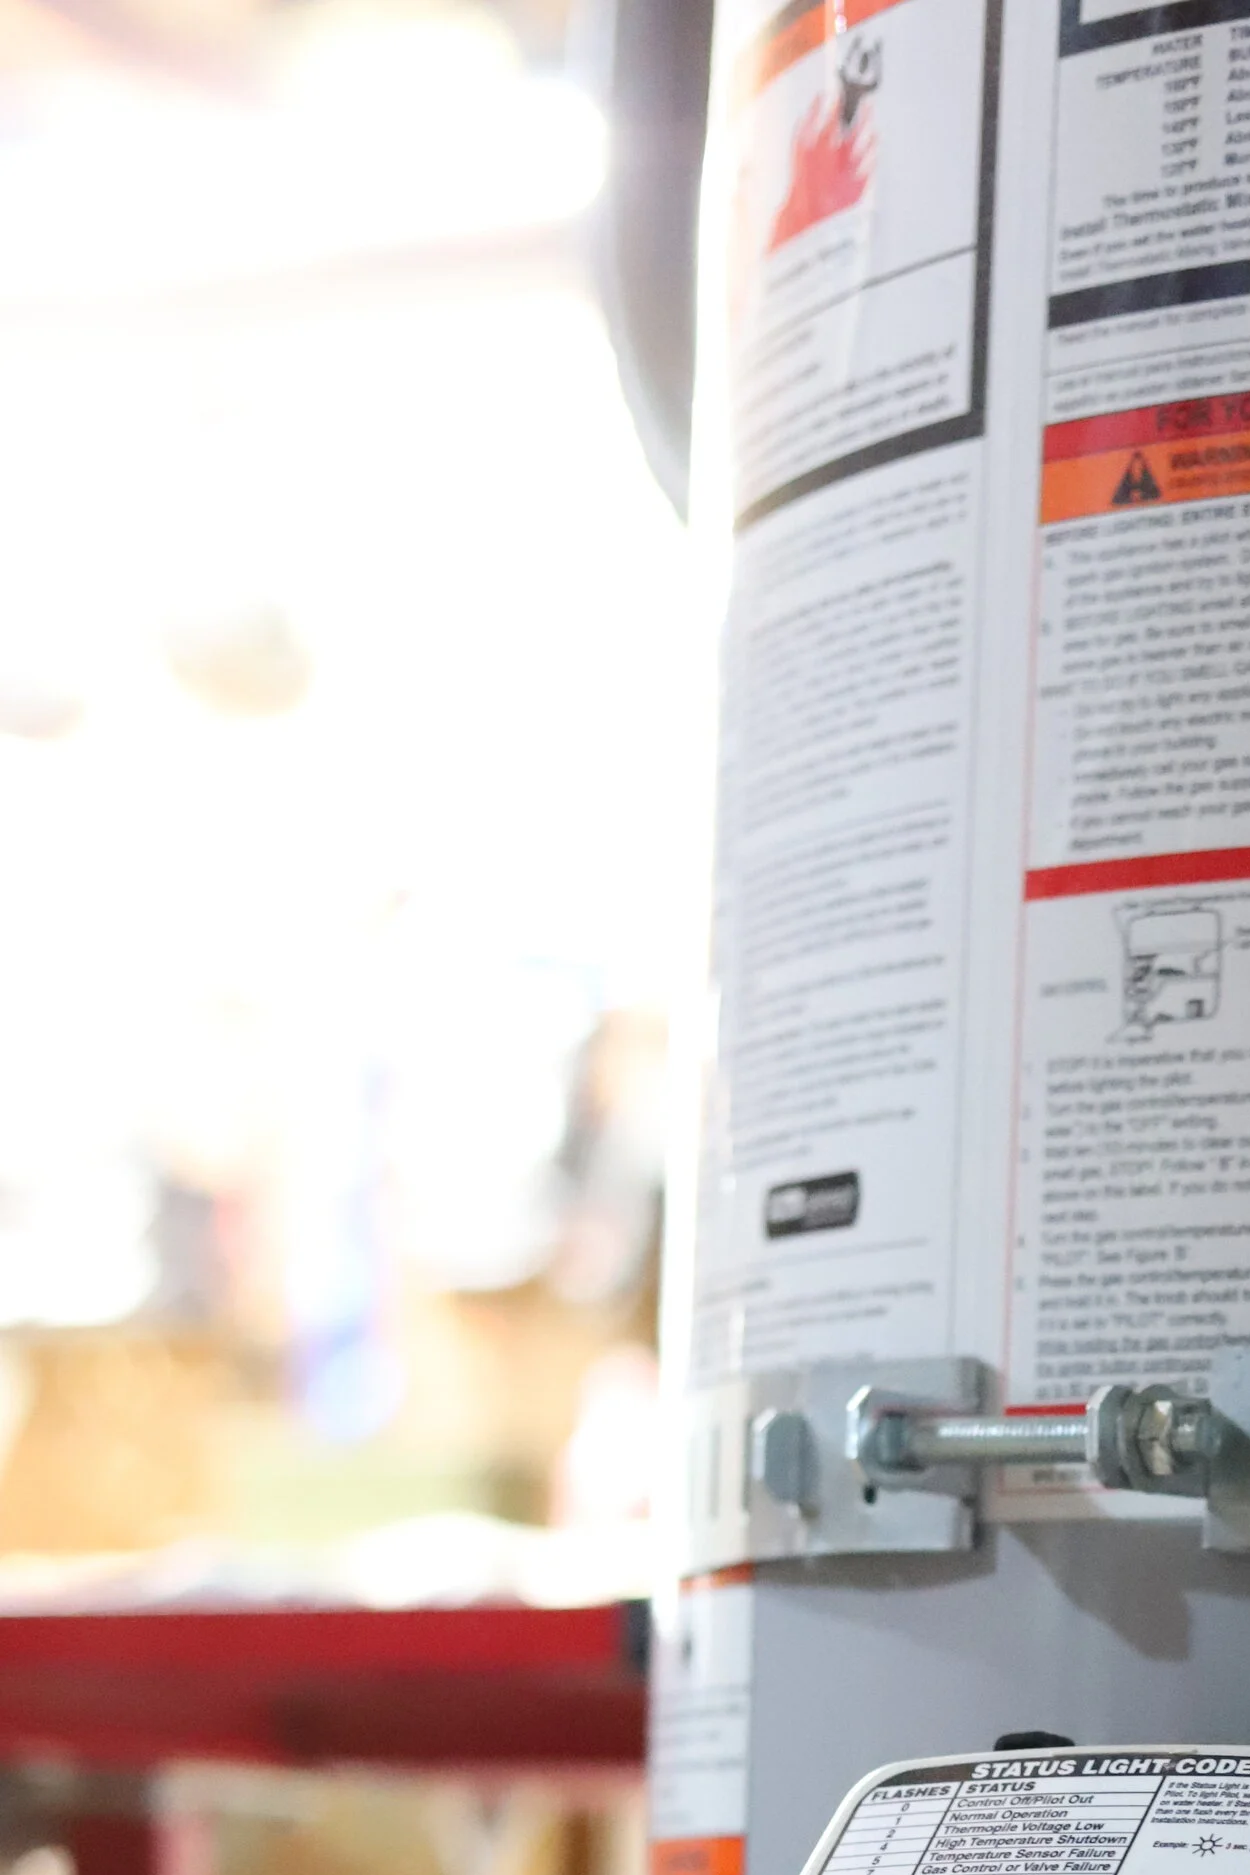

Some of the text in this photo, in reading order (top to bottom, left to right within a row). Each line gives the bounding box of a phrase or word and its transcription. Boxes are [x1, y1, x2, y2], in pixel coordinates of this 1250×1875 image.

[971, 1760, 1077, 1779] STATUS
[1082, 1759, 1172, 1776] LIGHT
[871, 1786, 952, 1802] FLASHES
[966, 1782, 1036, 1794] STATUS
[901, 1803, 910, 1812] 0
[956, 1794, 1094, 1808] Control Off/Pilot Out
[896, 1816, 902, 1826] 1
[950, 1809, 1068, 1822] Normal Operation
[885, 1829, 896, 1838] 2
[944, 1822, 1104, 1838] Thermopile Voltage Low
[934, 1834, 1128, 1850] High Temperature Shutdown
[871, 1856, 881, 1866] 5
[928, 1848, 1116, 1864] Temperature Sensor Failure
[921, 1865, 948, 1875] Gas
[952, 1863, 1003, 1874] Control
[1024, 1862, 1060, 1872] Valve
[1063, 1862, 1111, 1872] Failure
